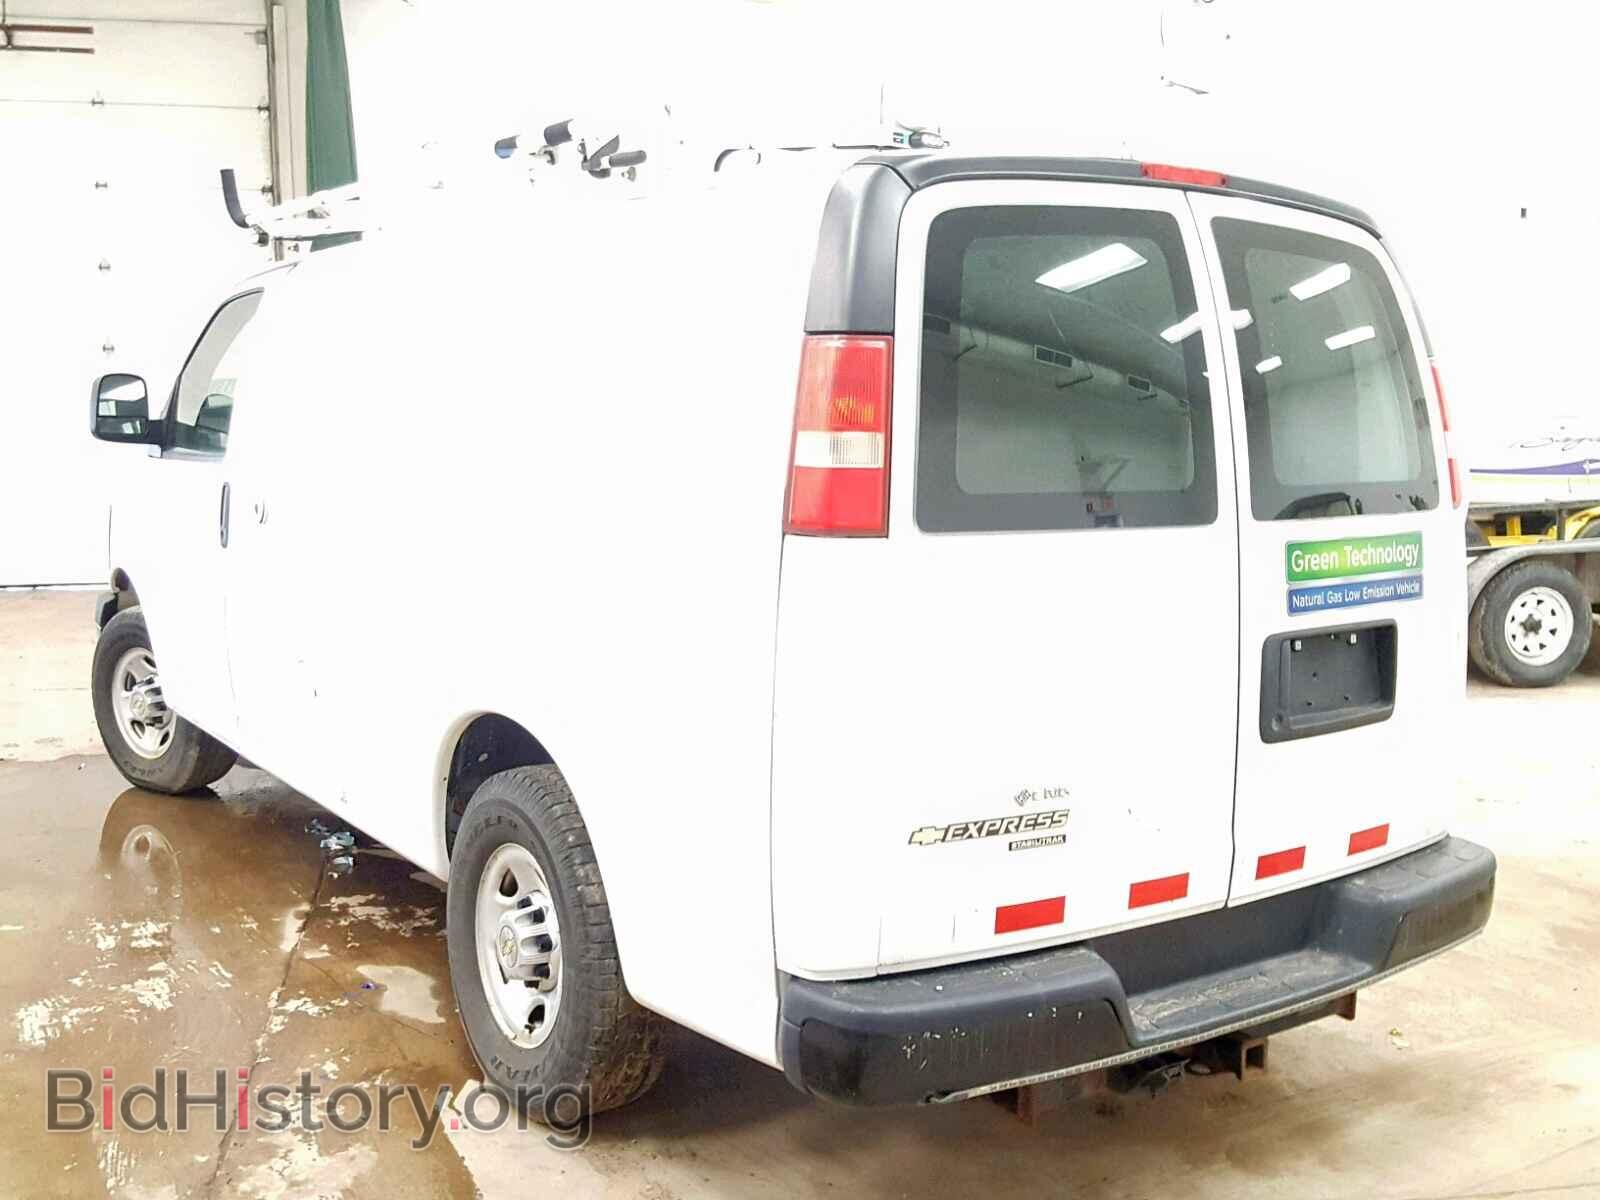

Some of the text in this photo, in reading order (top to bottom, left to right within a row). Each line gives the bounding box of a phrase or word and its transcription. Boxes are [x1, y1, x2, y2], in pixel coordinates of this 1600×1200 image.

[1291, 540, 1419, 573] Green Technology
[1292, 580, 1420, 608] Natural Gas Low Emission Vehicle
[942, 809, 1070, 842] EXPRESS
